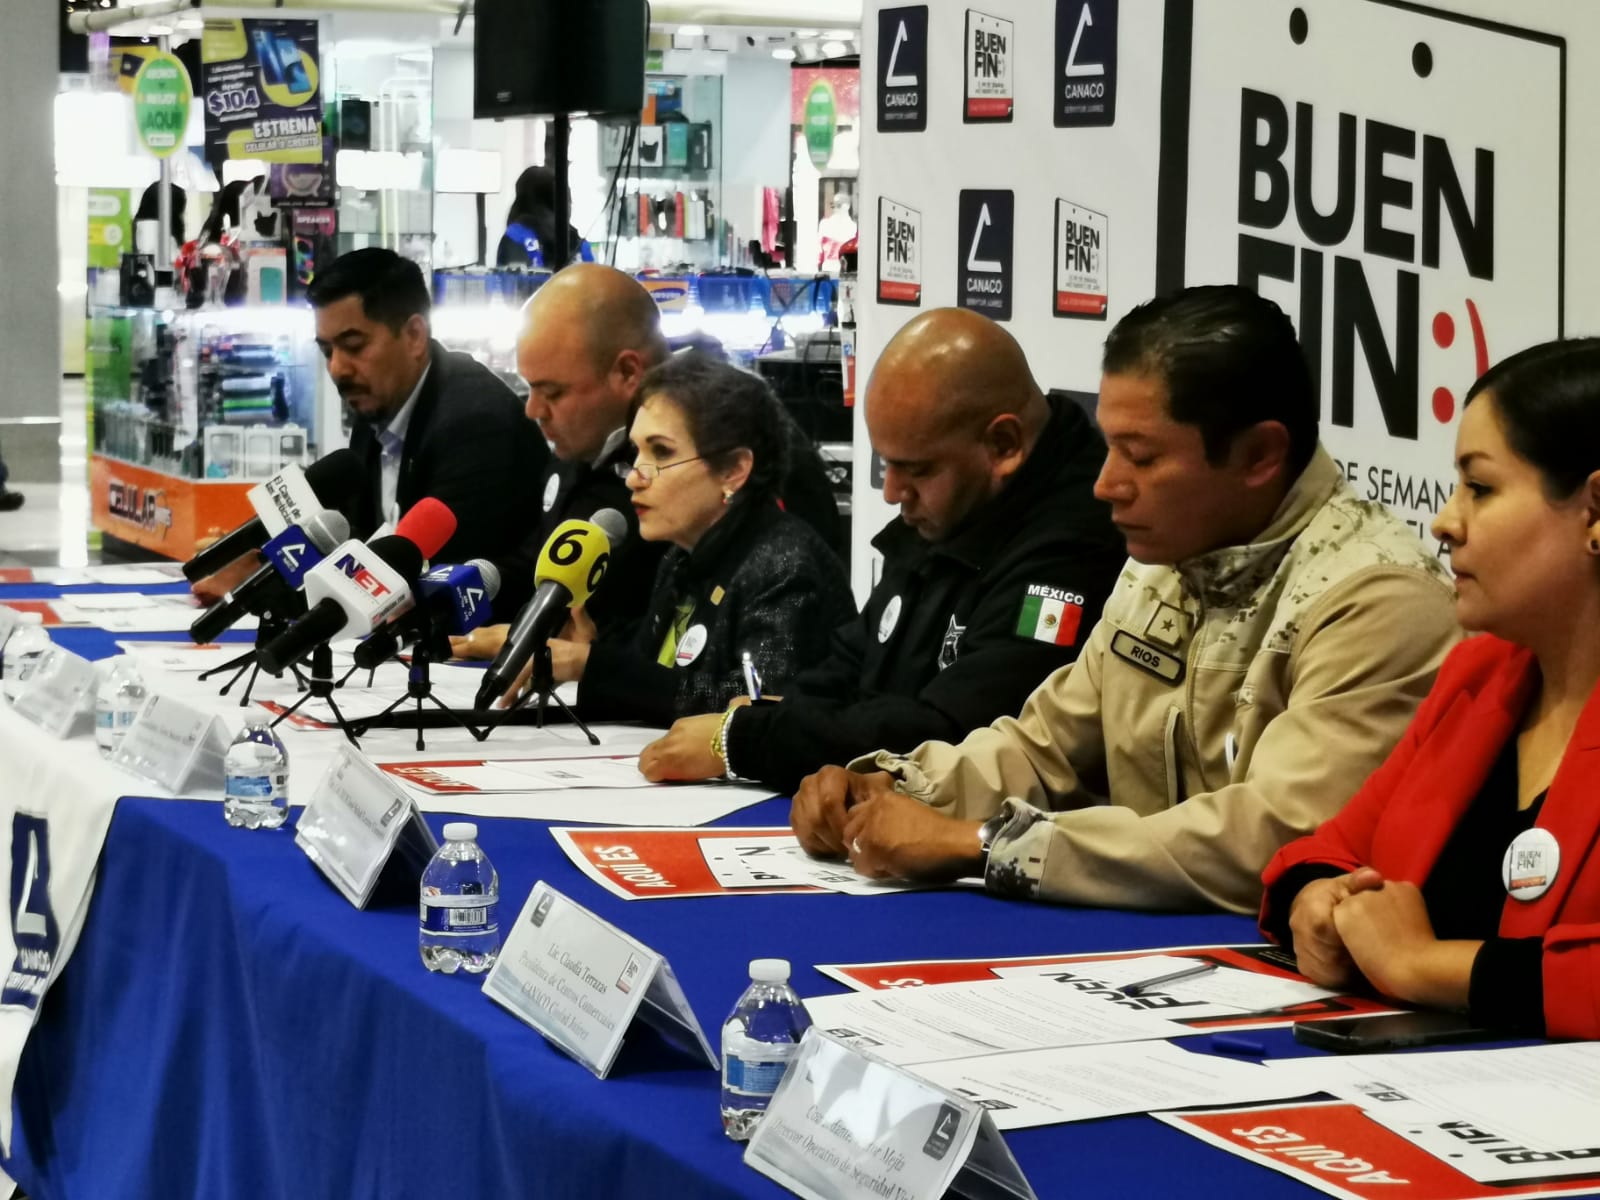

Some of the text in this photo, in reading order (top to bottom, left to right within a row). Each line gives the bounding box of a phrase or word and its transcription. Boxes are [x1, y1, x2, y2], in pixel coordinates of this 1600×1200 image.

[975, 30, 1006, 54] BUEN
[885, 92, 918, 107] CANACO
[1065, 82, 1105, 99] CANACO
[253, 117, 317, 139] ESTRENA
[1238, 87, 1495, 282] BUEN
[886, 216, 915, 243] BUEN
[1066, 220, 1100, 250] BUEN
[967, 278, 1002, 294] CANACO
[548, 528, 589, 566] 6
[334, 553, 392, 598] NET
[1026, 583, 1085, 606] MÉXICO
[1130, 644, 1161, 669] RIOS
[593, 845, 640, 861] ES
[1231, 1124, 1411, 1185] AQUÍ ES
